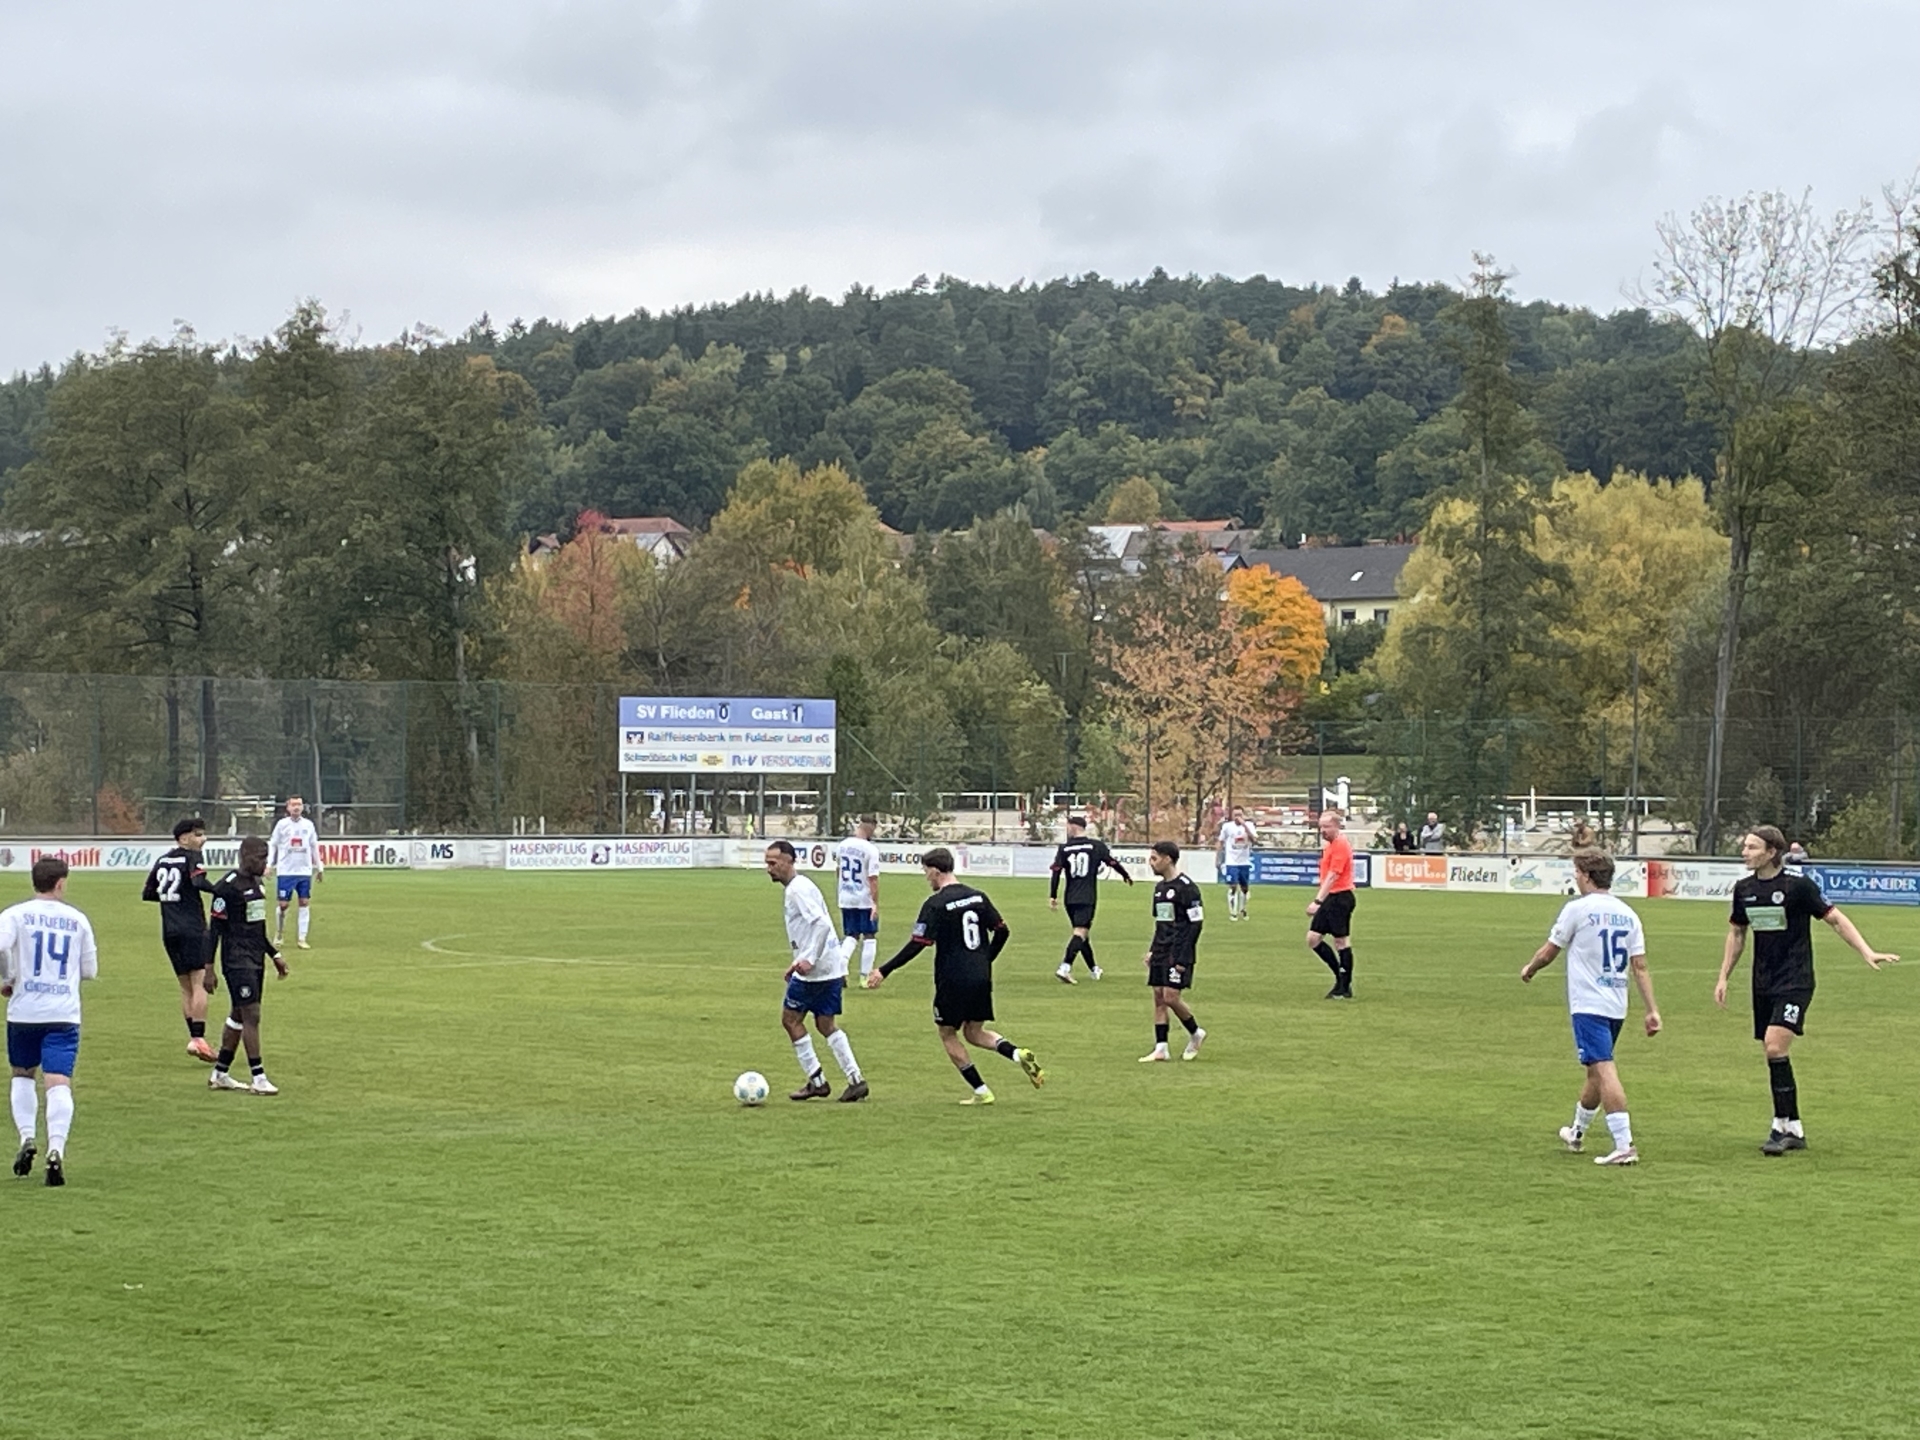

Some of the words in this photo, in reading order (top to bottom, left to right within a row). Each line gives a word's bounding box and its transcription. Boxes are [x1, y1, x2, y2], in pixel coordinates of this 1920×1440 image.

[636, 705, 657, 719] SV
[660, 705, 715, 719] Flieden
[718, 703, 731, 721] 0
[751, 707, 788, 720] Gast
[648, 732, 726, 742] Raiffeisenbank
[729, 732, 742, 742] im
[787, 734, 812, 743] Land
[680, 753, 697, 762] Hall
[761, 755, 832, 767] VERSICHERUNG
[106, 847, 151, 866] Pils
[431, 844, 453, 859] MS
[510, 843, 587, 854] HASENPFLUG
[615, 842, 690, 854] HASENPFLUG
[841, 856, 862, 884] 22
[1067, 852, 1090, 878] 10
[1388, 860, 1446, 882] tegut...
[1450, 866, 1498, 882] Flieden
[156, 867, 181, 901] 22
[23, 913, 35, 925] SV
[39, 914, 78, 932] FLIEDEN
[962, 910, 980, 950] 6
[31, 930, 71, 980] 14
